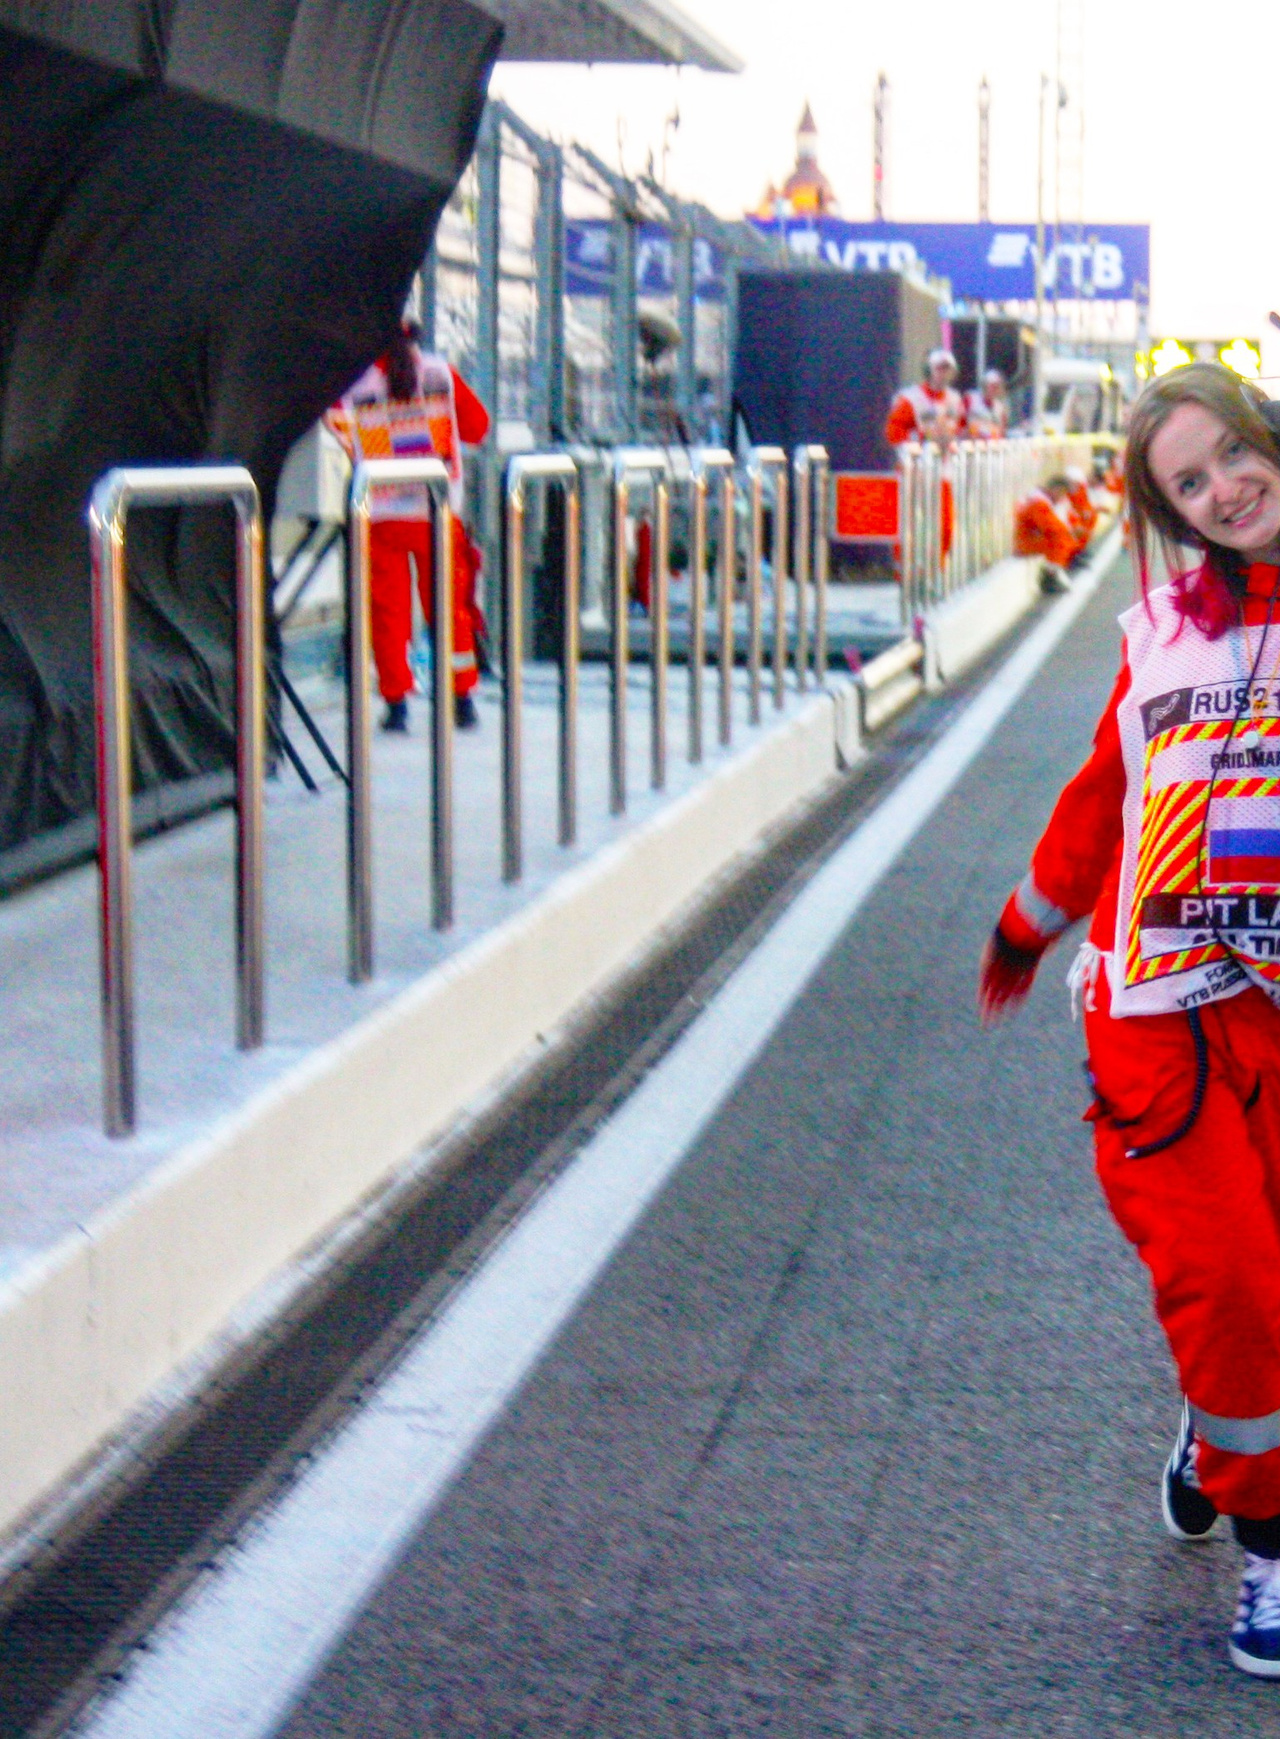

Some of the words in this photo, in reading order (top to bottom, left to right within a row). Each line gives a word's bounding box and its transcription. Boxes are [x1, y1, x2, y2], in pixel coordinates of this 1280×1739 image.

[1030, 243, 1124, 289] VTB
[1210, 753, 1246, 769] GRID
[1181, 898, 1239, 926] PIT
